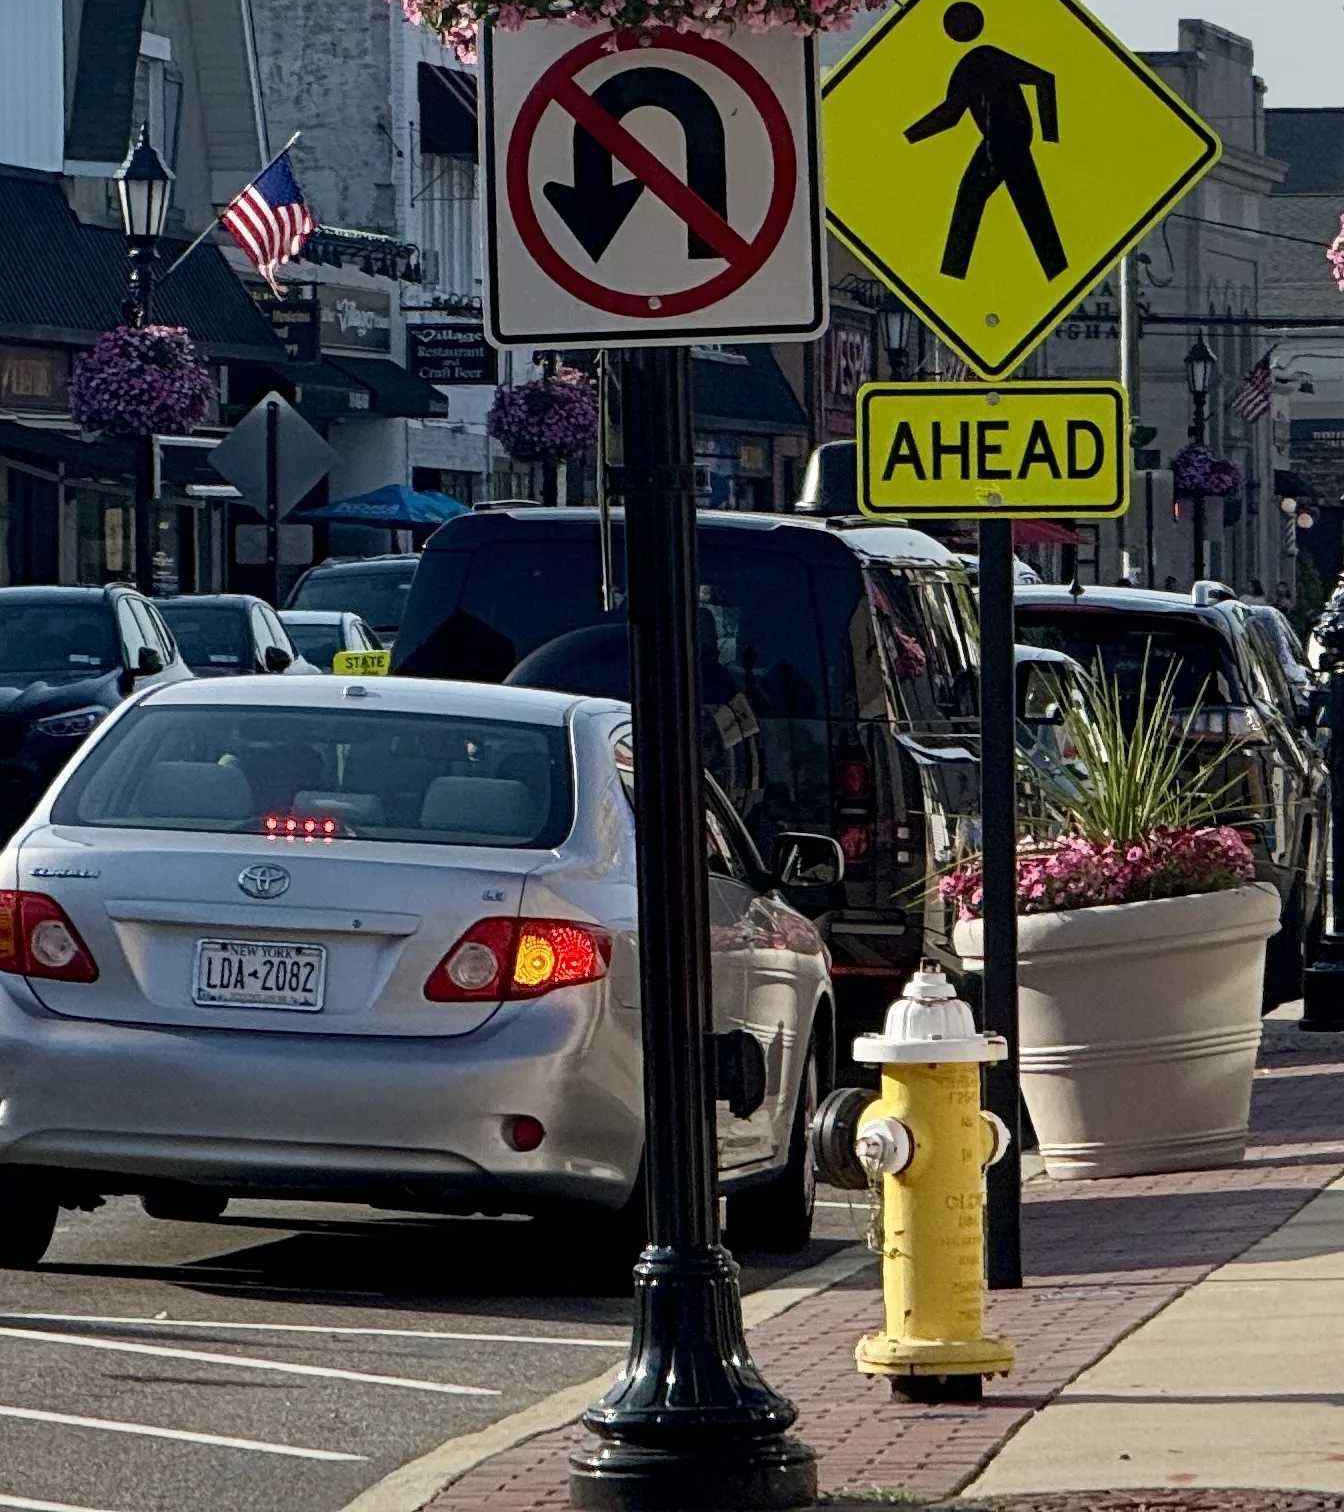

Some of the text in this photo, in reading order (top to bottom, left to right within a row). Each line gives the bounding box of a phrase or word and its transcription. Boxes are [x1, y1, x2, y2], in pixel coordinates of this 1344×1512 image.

[415, 328, 484, 343] Village
[416, 345, 486, 358] Restaurant
[418, 366, 452, 379] Craft
[881, 419, 1105, 481] AHEAD
[345, 655, 385, 669] STATE
[230, 944, 293, 959] NEW YORK
